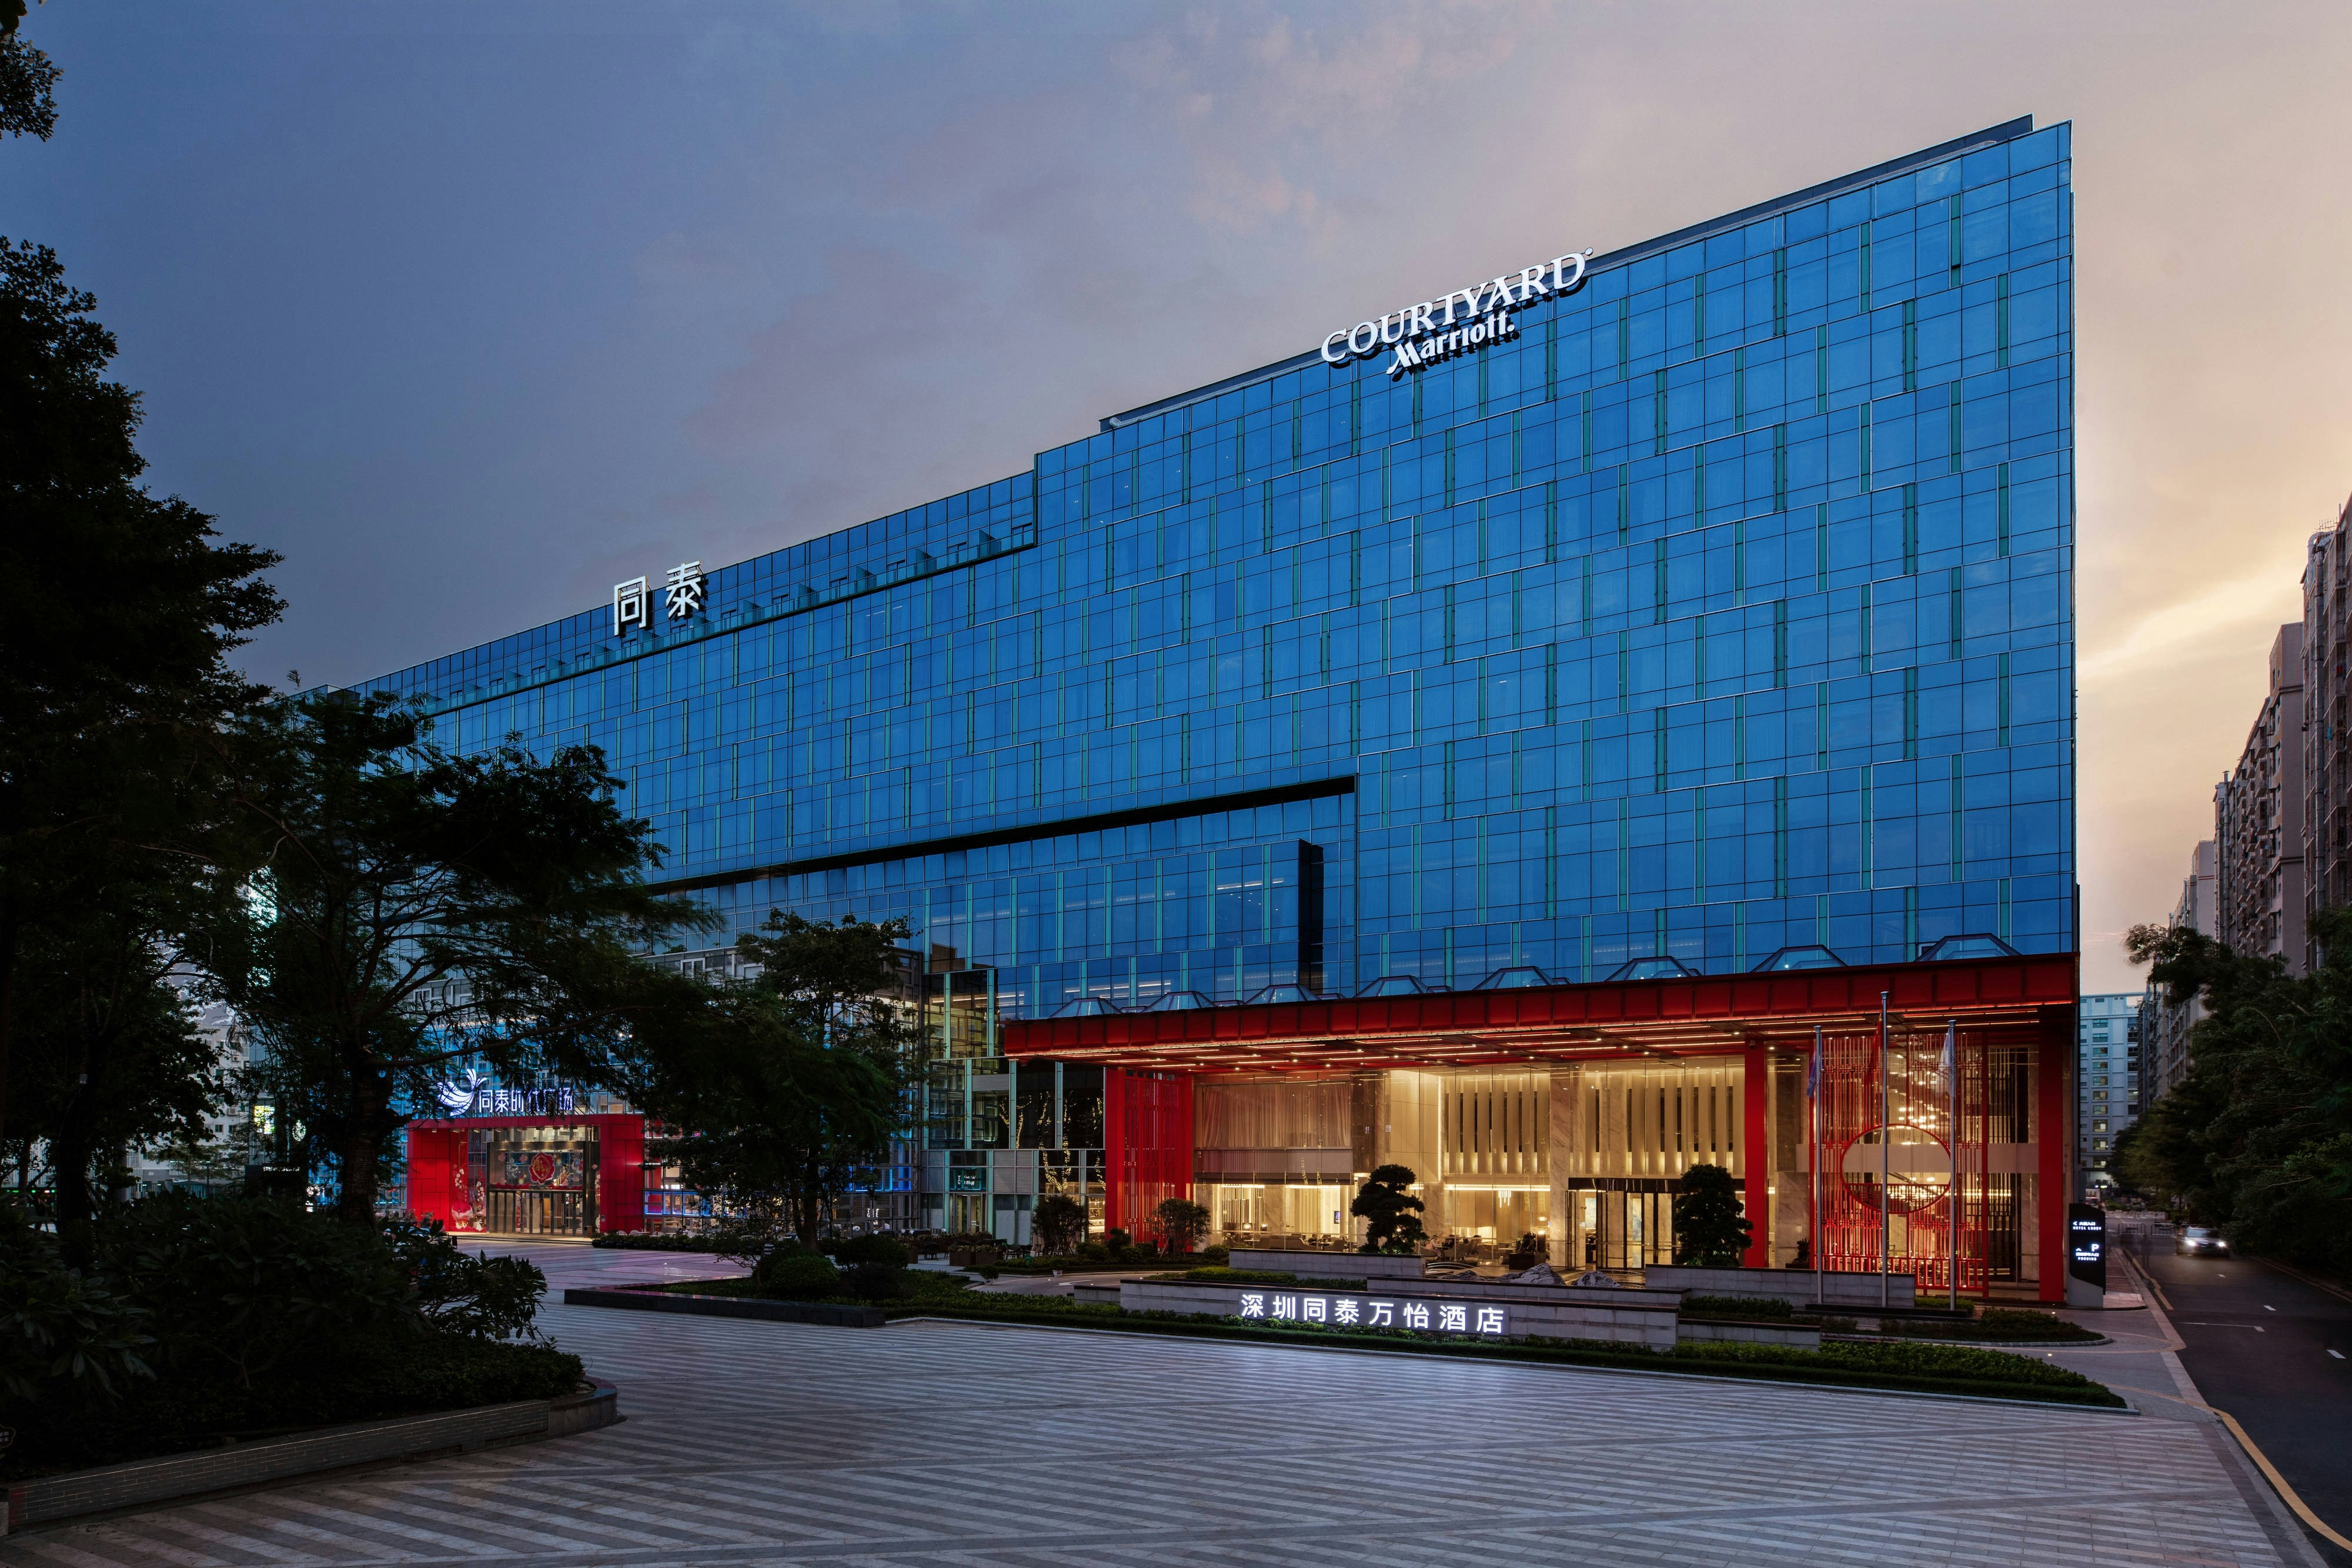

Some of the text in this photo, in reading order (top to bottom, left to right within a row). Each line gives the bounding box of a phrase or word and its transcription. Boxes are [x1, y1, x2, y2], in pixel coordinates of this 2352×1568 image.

[1321, 252, 1587, 363] COURTYARD
[1386, 309, 1509, 375] Marriott
[614, 560, 701, 636] 同泰
[2092, 1243, 2099, 1252] P
[1241, 1293, 1504, 1334] 深圳同泰万怡酒店
